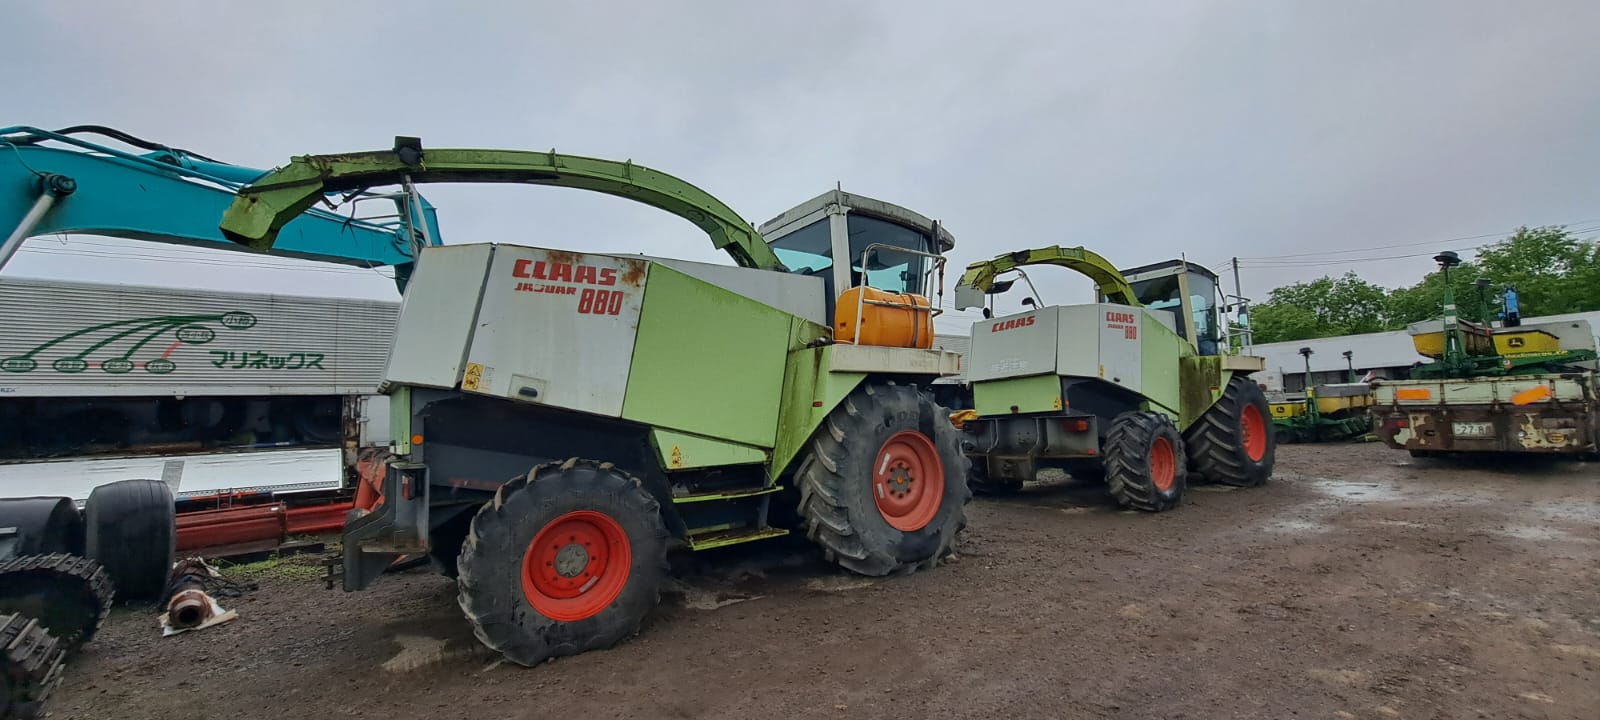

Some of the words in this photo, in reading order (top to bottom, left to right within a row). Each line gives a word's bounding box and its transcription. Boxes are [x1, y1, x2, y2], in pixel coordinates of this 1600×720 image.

[513, 260, 617, 286] CLAAS
[578, 289, 624, 315] 880
[991, 316, 1036, 333] CLAAS
[1106, 312, 1134, 324] CLAAS
[210, 350, 325, 370] マリネックス
